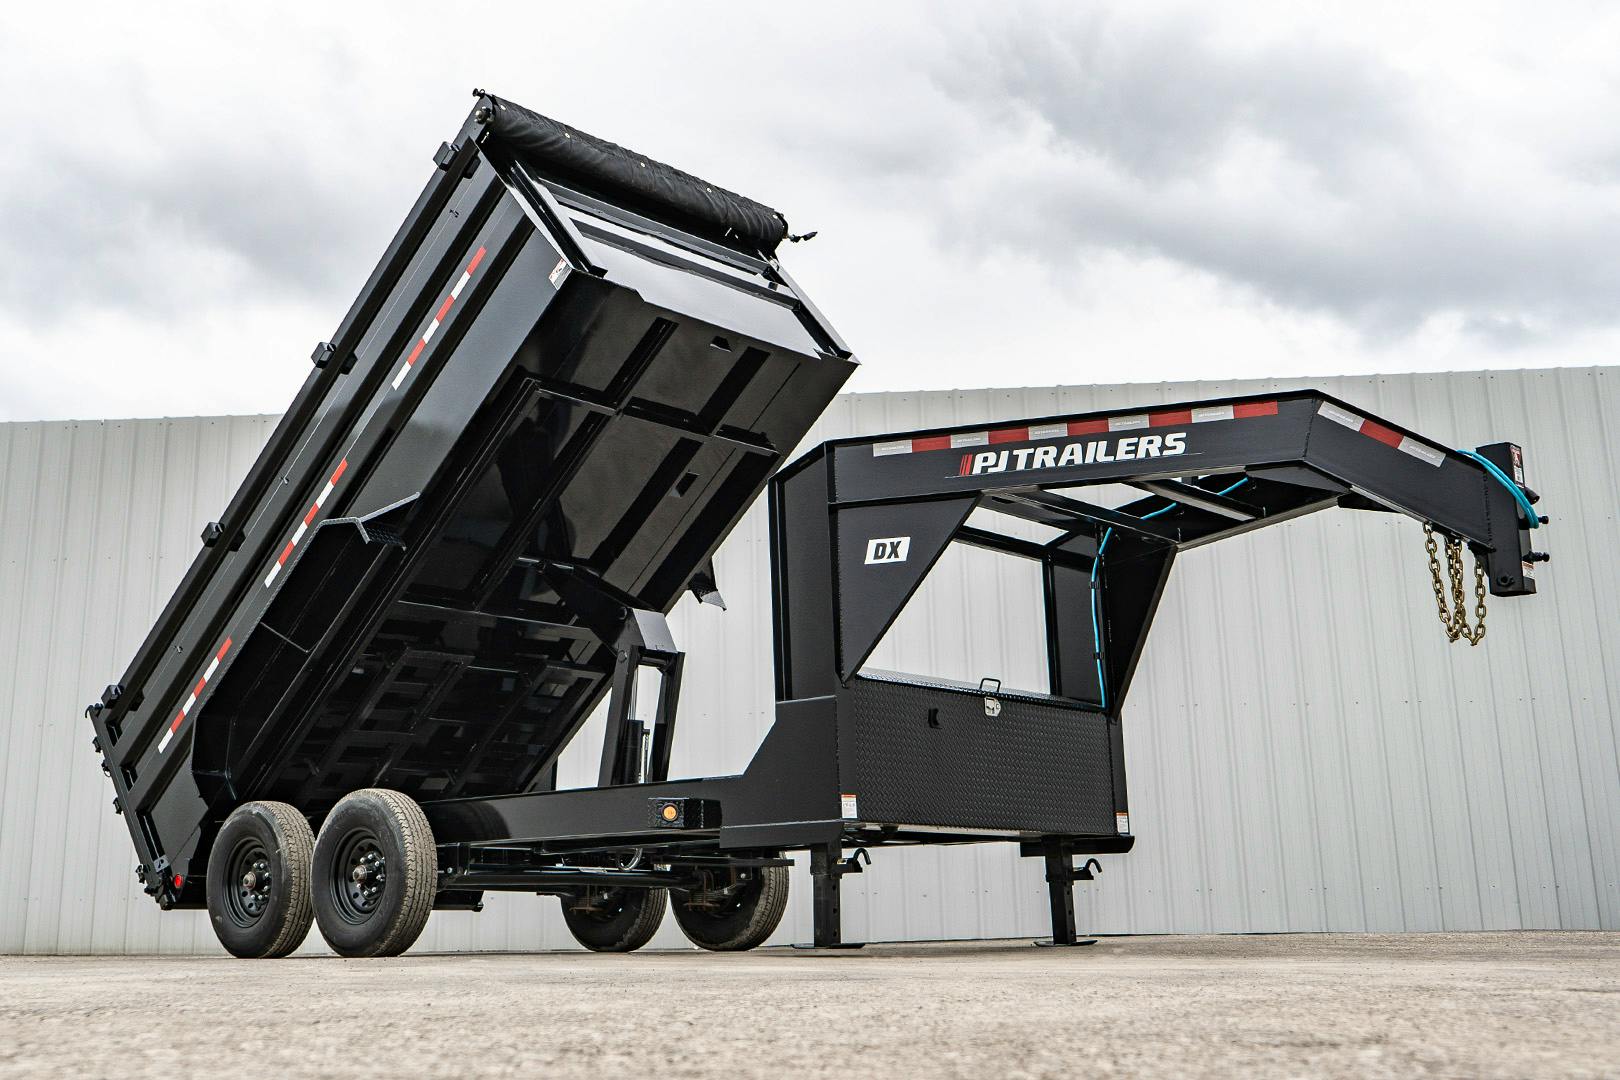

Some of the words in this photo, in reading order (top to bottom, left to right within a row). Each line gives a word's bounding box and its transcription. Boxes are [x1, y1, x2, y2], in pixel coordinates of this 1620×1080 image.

[972, 450, 1009, 475] PJ
[1013, 432, 1187, 471] TRAILERS
[873, 541, 902, 560] DX
